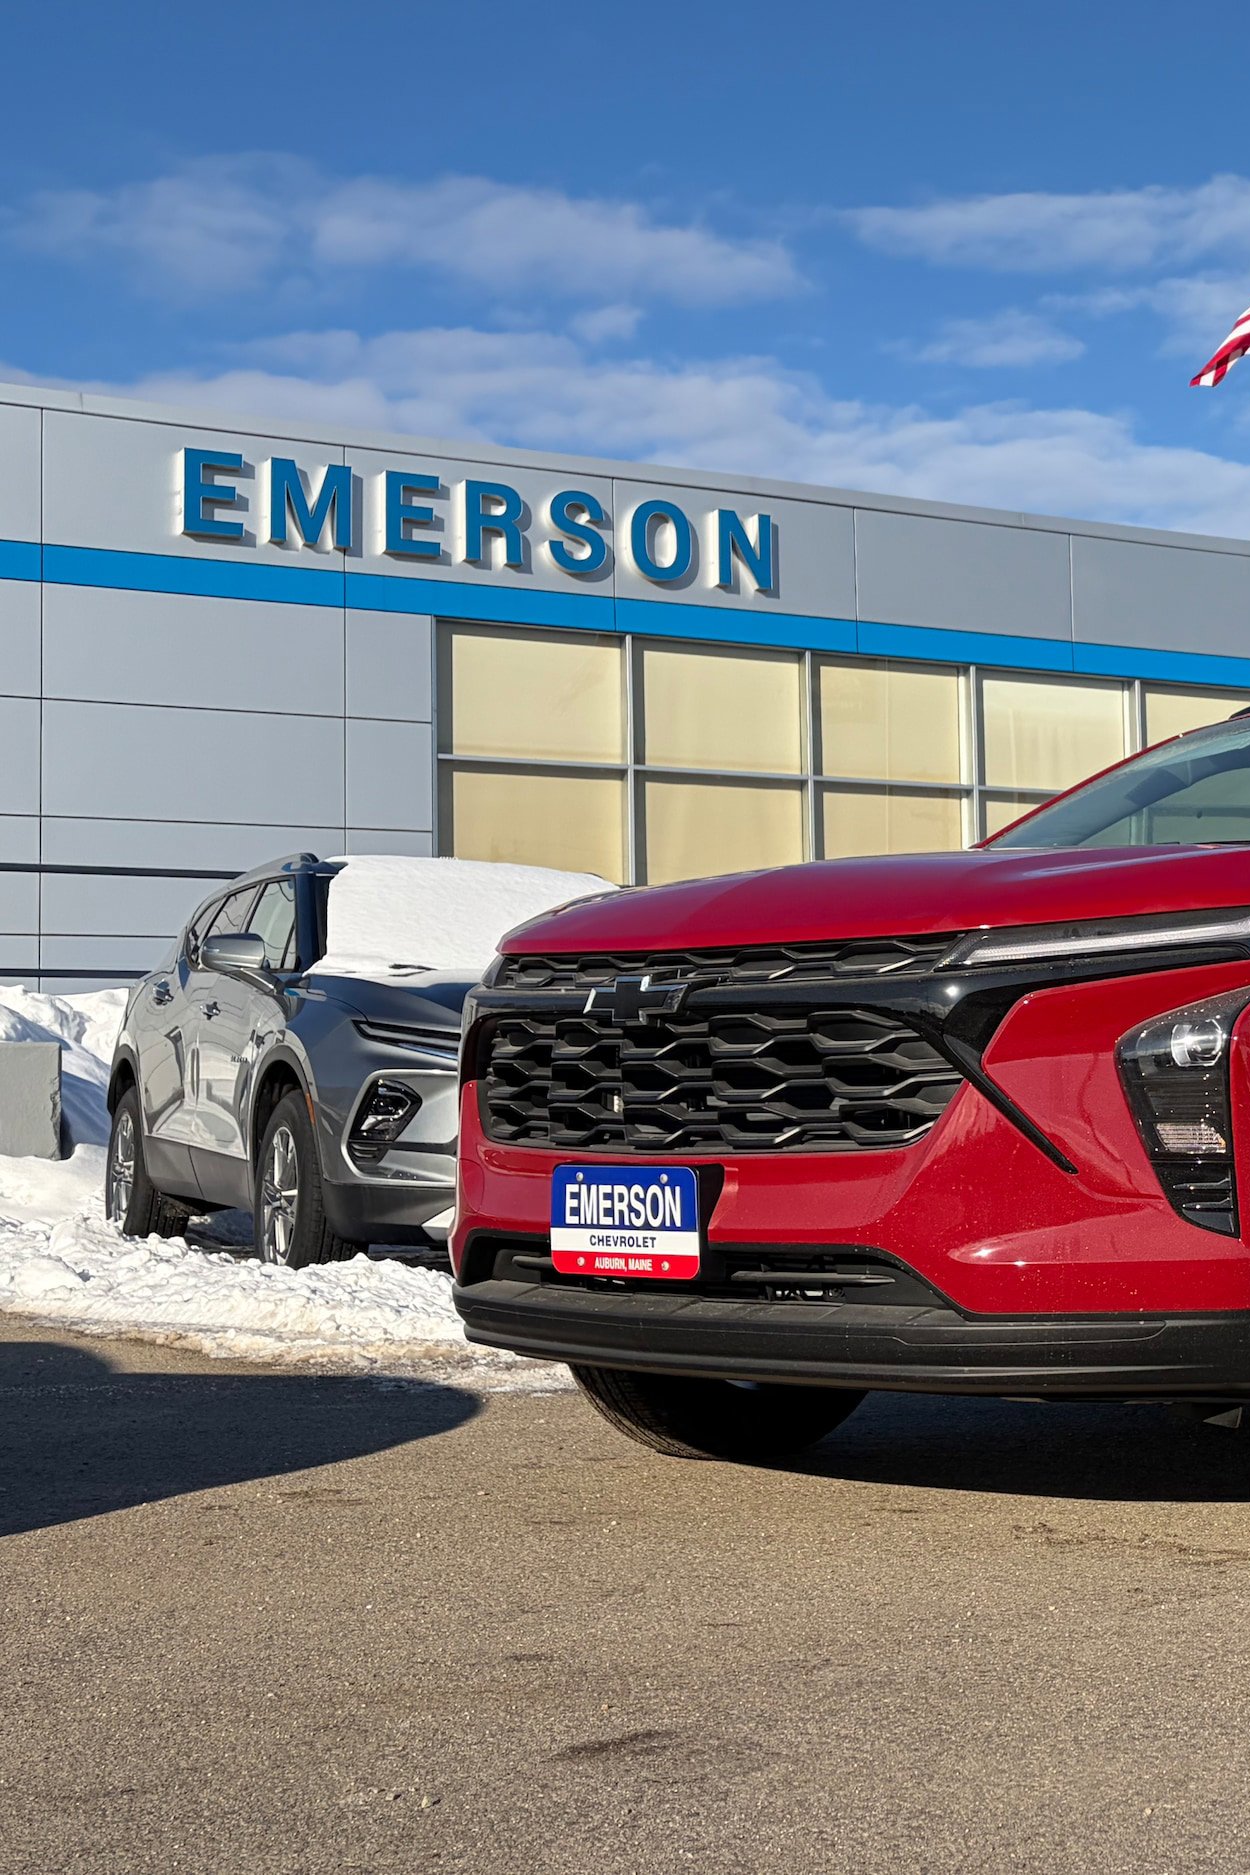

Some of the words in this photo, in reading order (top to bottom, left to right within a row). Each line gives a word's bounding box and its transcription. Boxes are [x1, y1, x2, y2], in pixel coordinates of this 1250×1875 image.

[180, 447, 773, 592] EMERSON
[565, 1184, 682, 1228] EMERSON
[589, 1234, 657, 1249] CHEVROLET
[594, 1256, 627, 1272] AUBURN,
[628, 1258, 653, 1272] MAINE
